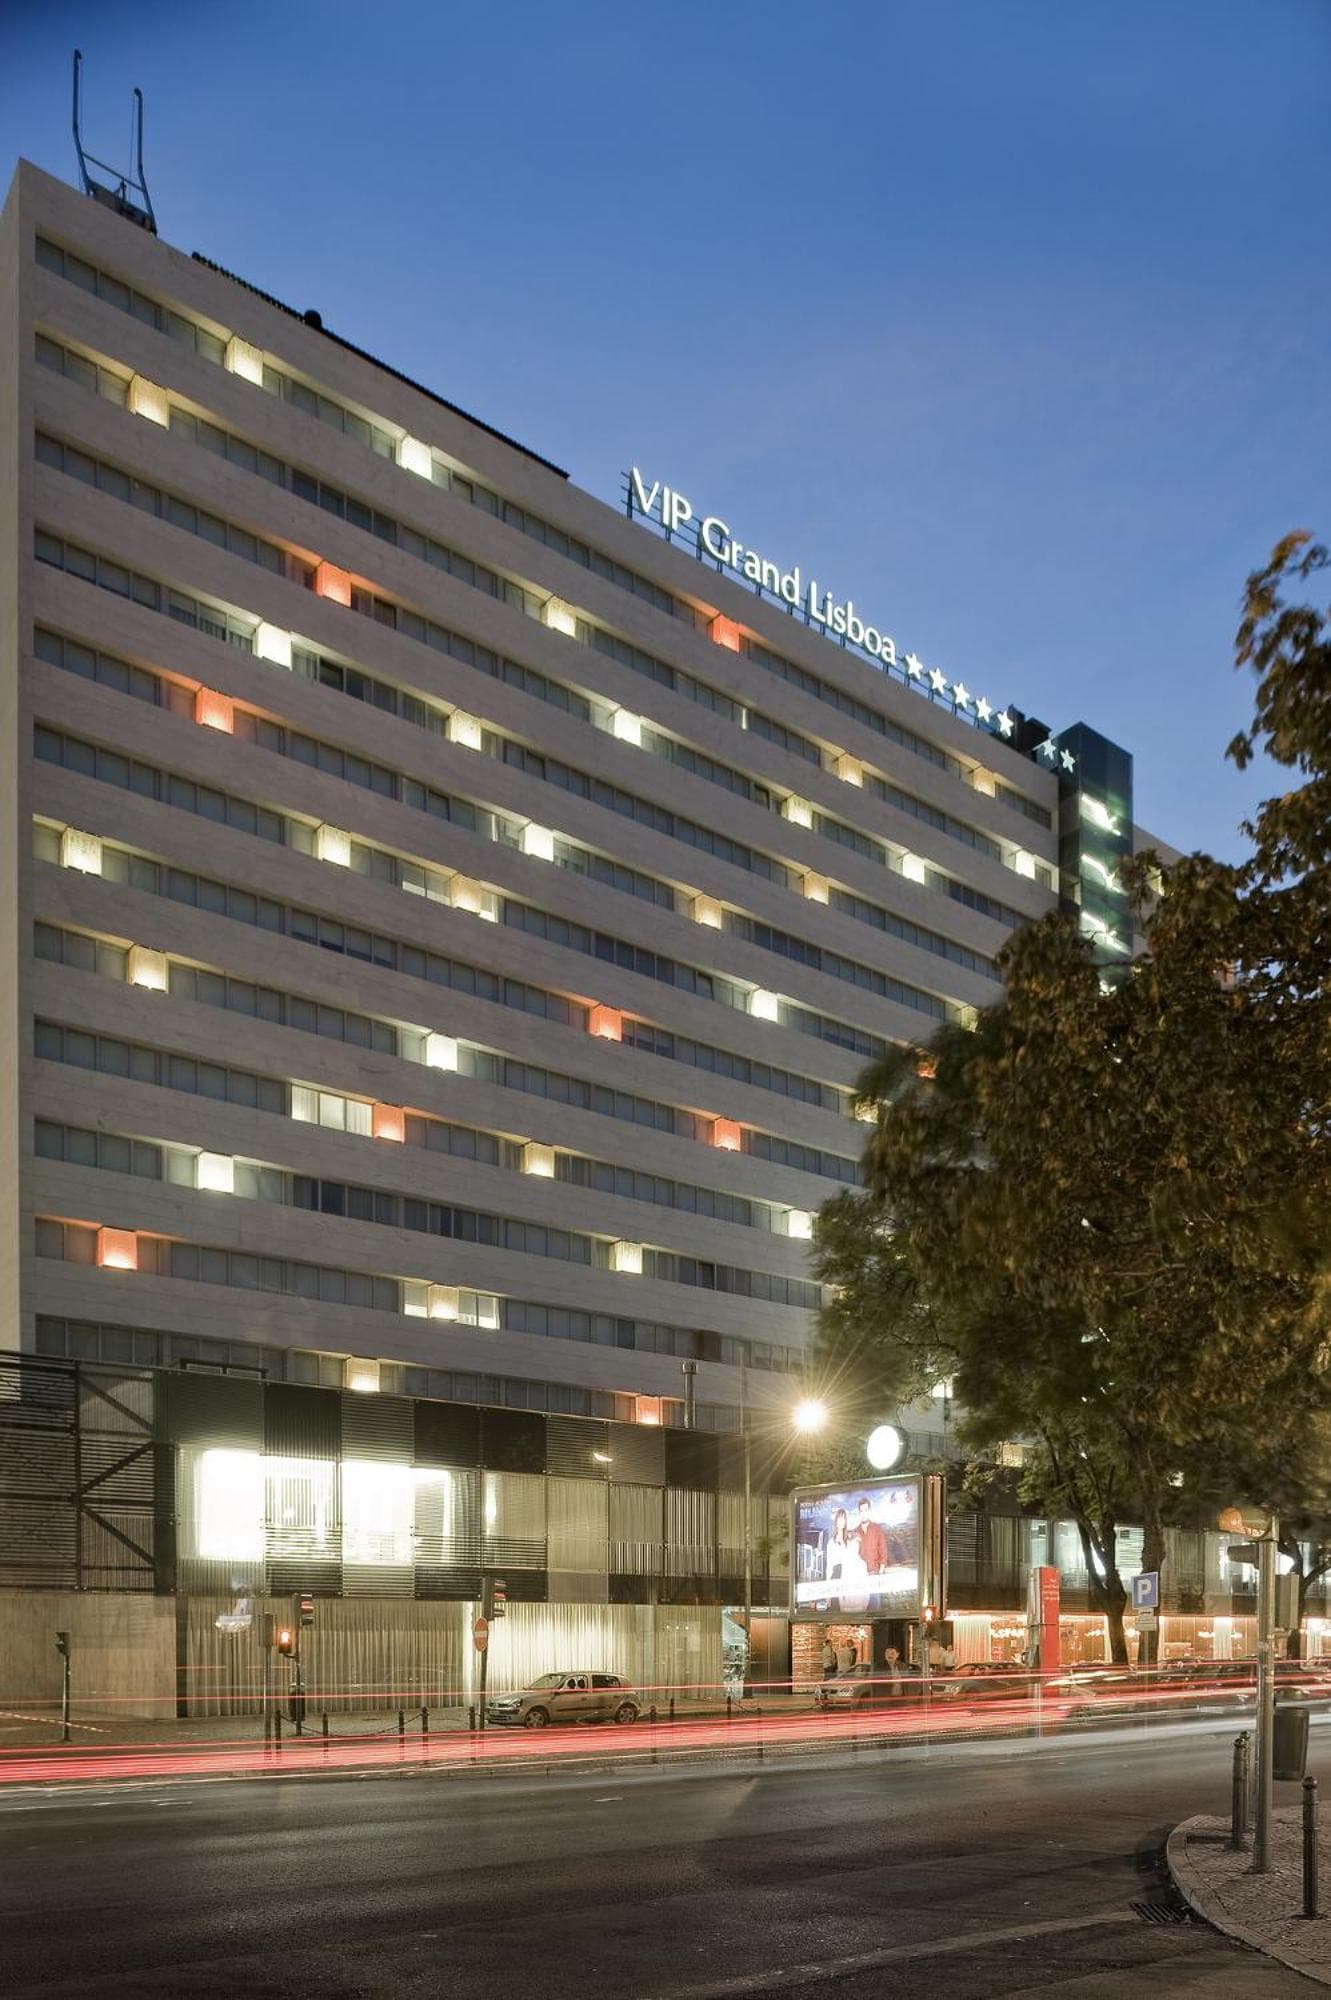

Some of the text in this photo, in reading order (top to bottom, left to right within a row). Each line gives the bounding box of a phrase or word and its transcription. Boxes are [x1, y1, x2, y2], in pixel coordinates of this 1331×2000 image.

[632, 466, 897, 666] VIP Grand Lisboa
[1137, 1578, 1152, 1604] P
